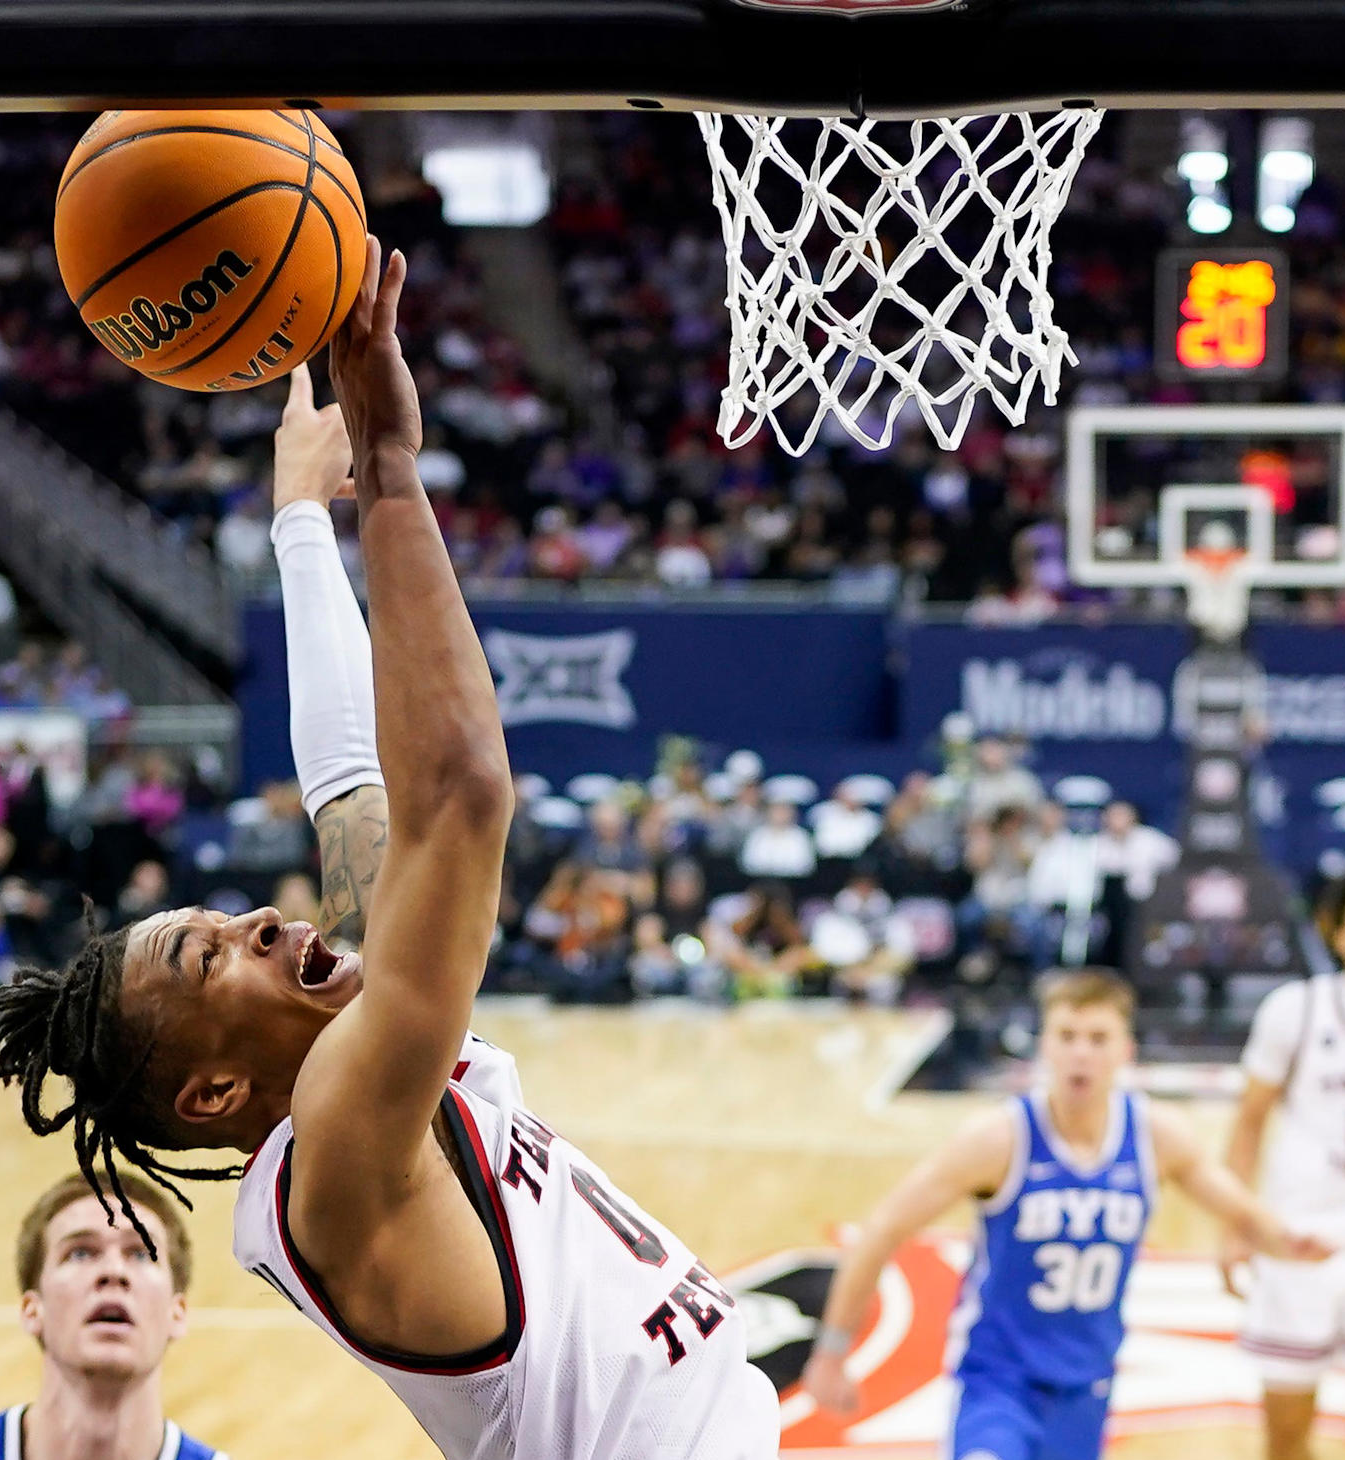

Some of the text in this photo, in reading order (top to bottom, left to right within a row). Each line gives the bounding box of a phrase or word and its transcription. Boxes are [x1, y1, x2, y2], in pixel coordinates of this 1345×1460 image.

[89, 249, 254, 362] Wilson
[1014, 1188, 1144, 1244] BYU
[1028, 1242, 1123, 1313] 30
